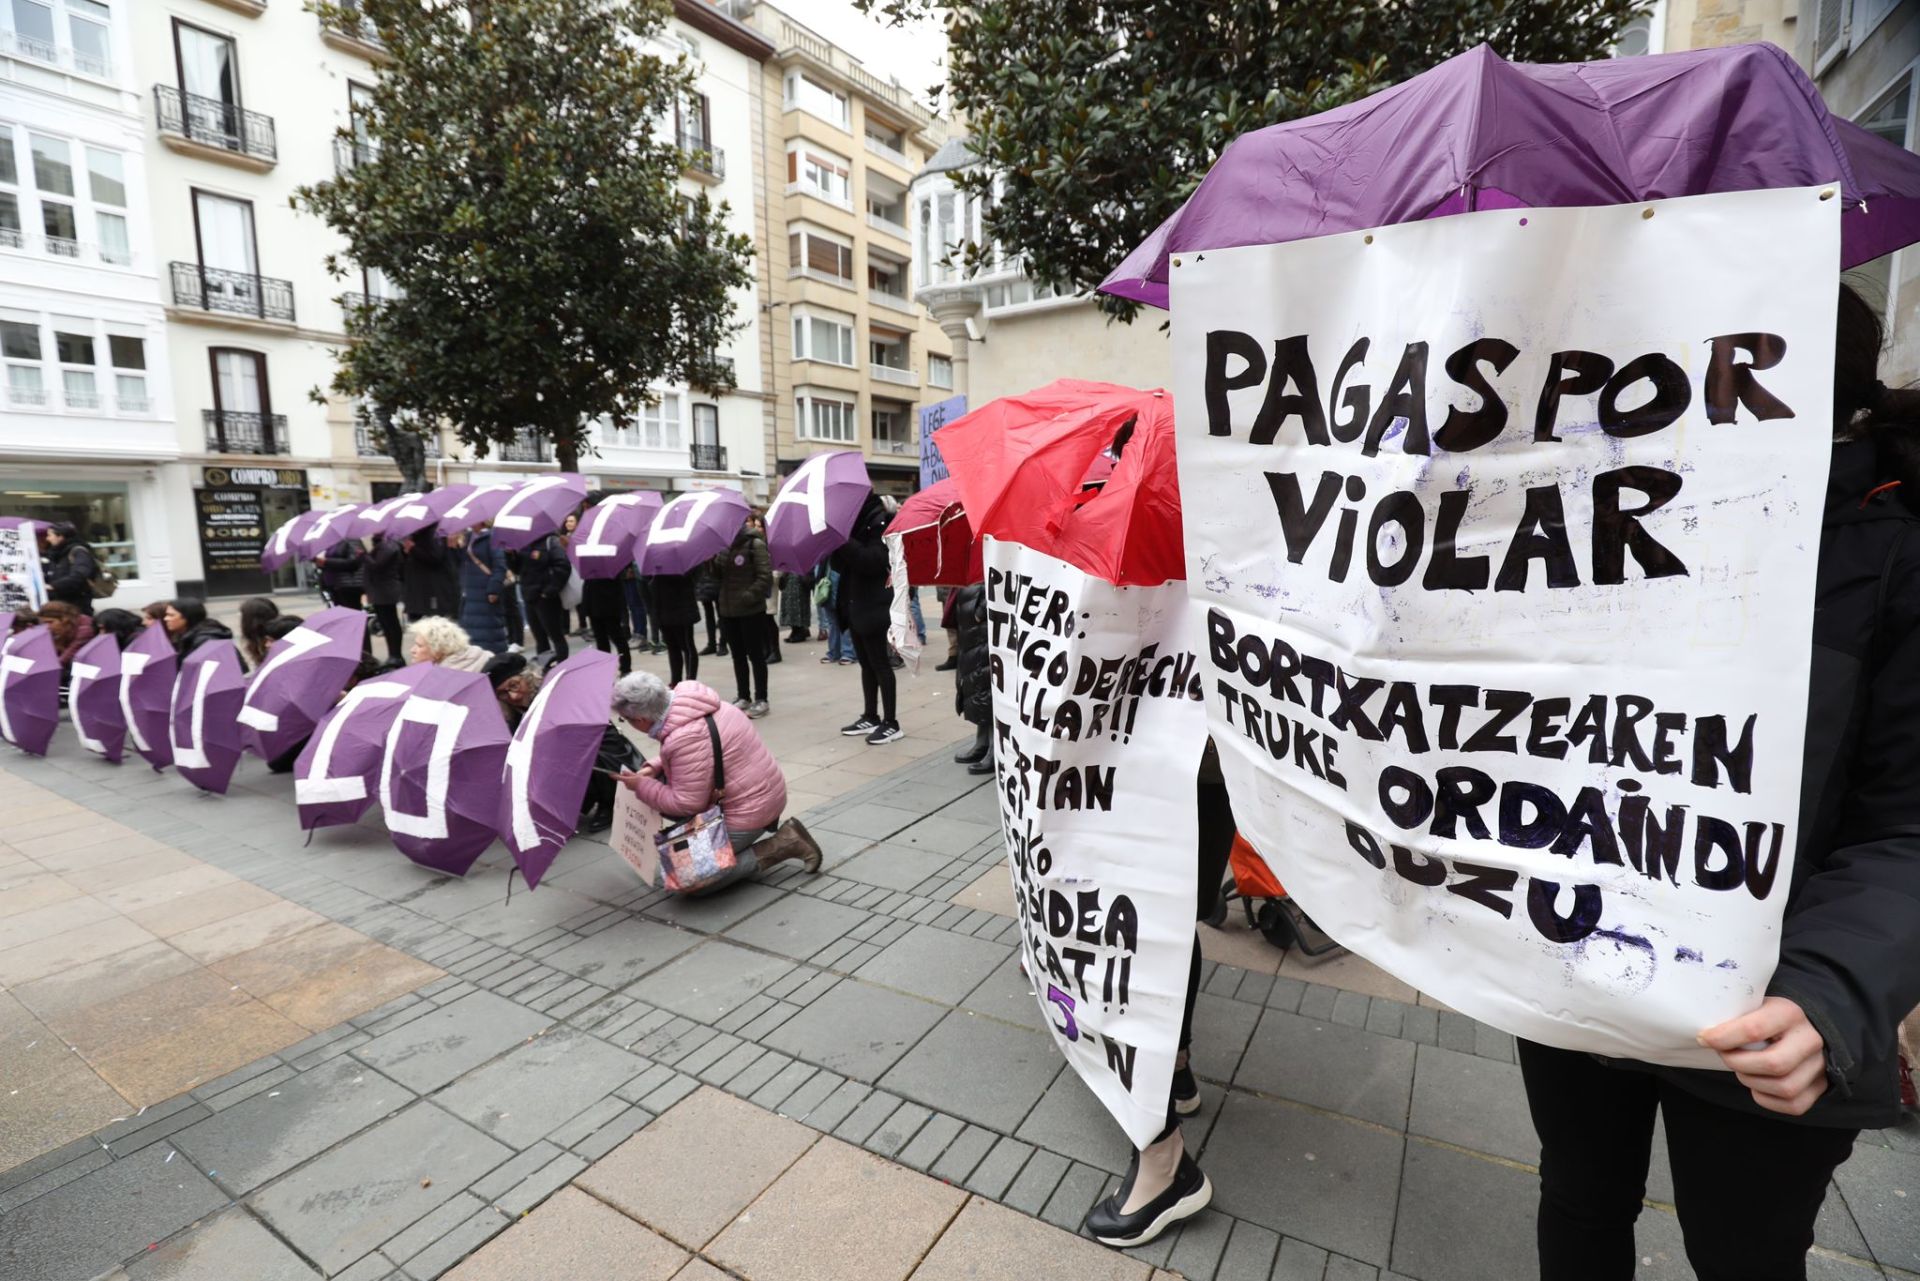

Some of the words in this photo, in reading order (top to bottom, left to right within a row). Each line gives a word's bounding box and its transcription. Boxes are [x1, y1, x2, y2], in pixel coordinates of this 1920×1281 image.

[1205, 330, 1521, 457] PAGAS
[1534, 332, 1796, 444] POR
[231, 468, 278, 485] COMPRO
[1206, 606, 1758, 794] BORTXATZEAREN
[1216, 678, 1347, 791] TRUKE
[1345, 818, 1603, 944] DUZU
